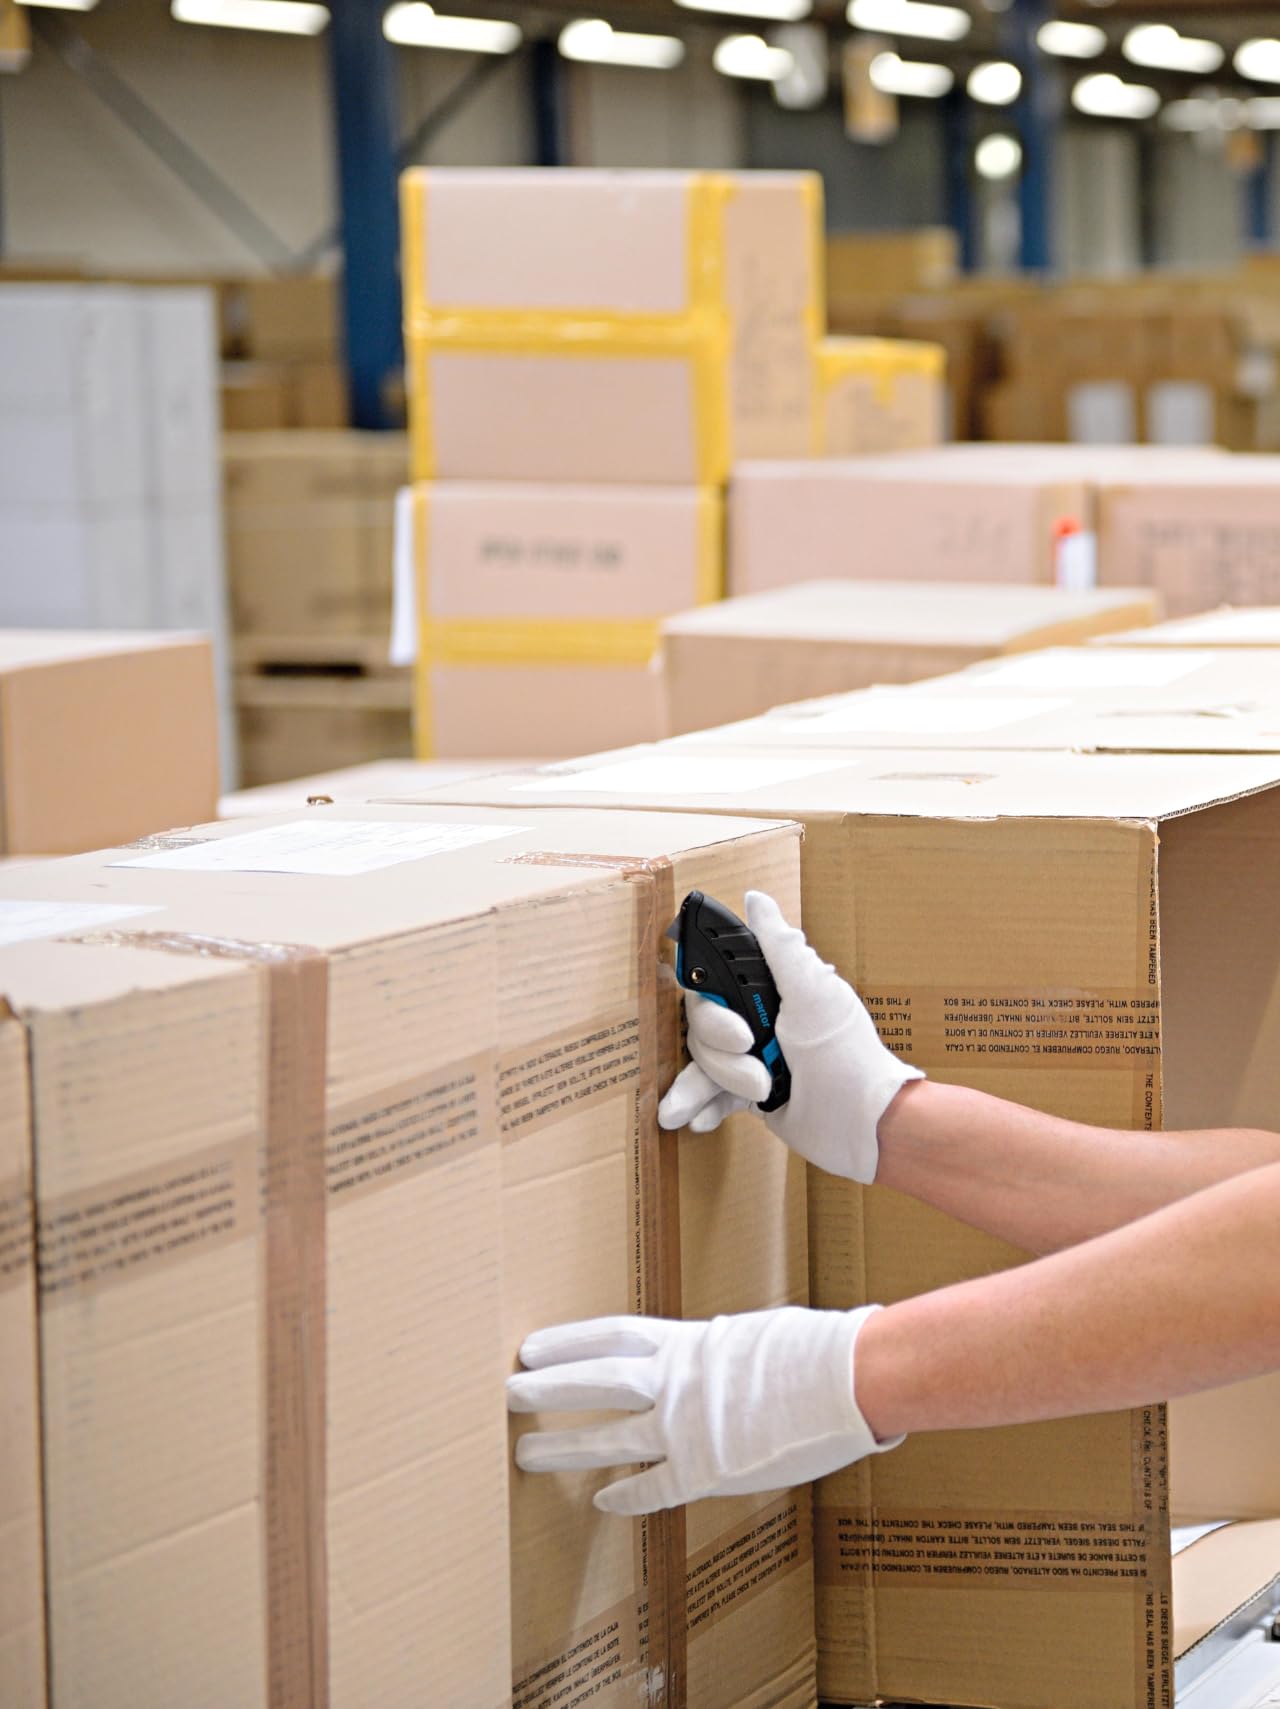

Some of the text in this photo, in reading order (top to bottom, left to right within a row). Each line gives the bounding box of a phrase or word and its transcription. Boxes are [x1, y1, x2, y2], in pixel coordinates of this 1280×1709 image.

[1148, 943, 1156, 985] TAMPERED
[866, 996, 910, 1006] IF THIS SEAL
[944, 998, 958, 1007] BOX
[961, 998, 974, 1007] THE
[978, 998, 987, 1007] OF
[990, 998, 1028, 1008] CONTENTS
[1031, 999, 1044, 1008] THE
[1048, 999, 1073, 1008] CHECK
[1075, 999, 1104, 1008] PLEASE
[1107, 999, 1127, 1008] WITH,
[752, 992, 771, 1028] martor
[944, 1014, 992, 1024] ÜBERPRÜFEN
[996, 1014, 1022, 1023] INHALT
[1059, 1015, 1079, 1024] BIT
[1083, 1015, 1112, 1024] SOLLTE,
[1116, 1015, 1133, 1024] SEIN
[881, 1028, 911, 1036] SI CETTE
[945, 1029, 1159, 1039] A ETE ALTEREE VEUILLEZ VERIFIER LE CONTENU DE LA BOITE
[906, 1042, 912, 1052] SI
[946, 1043, 963, 1052] CAJA
[965, 1043, 974, 1052] LA
[977, 1043, 986, 1052] DE
[988, 1043, 1029, 1053] CONTENIDO
[1032, 1044, 1040, 1053] EL
[1042, 1044, 1092, 1053] COMPRUEBEN
[1094, 1044, 1120, 1054] RUEGO
[1145, 1073, 1154, 1088] THE
[870, 1518, 879, 1528] OF
[881, 1519, 918, 1528] CONTENTS
[921, 1519, 933, 1529] THE
[937, 1520, 961, 1529] CHECK
[964, 1520, 991, 1530] PLEASE
[995, 1521, 1014, 1530] WITH,
[1016, 1521, 1055, 1531] TAMPERED
[1057, 1522, 1078, 1531] BEEN
[1080, 1522, 1095, 1531] HAS
[1098, 1522, 1116, 1532] SEAL
[1119, 1523, 1134, 1532] THIS
[888, 1534, 912, 1543] INHALT
[915, 1534, 944, 1544] KARTON
[948, 1535, 968, 1544] BITTE
[972, 1535, 1000, 1545] SOLLTE,
[1003, 1536, 1020, 1545] SEIN
[1024, 1536, 1060, 1546] VERLETZT
[1064, 1537, 1090, 1546] SIEGEL
[1092, 1538, 1119, 1547] DIESES
[1122, 1538, 1144, 1548] FALLS
[881, 1549, 914, 1558] CONTENU
[916, 1549, 924, 1559] LE
[926, 1550, 956, 1559] VERIFIER
[959, 1550, 991, 1560] VEUILLEZ
[993, 1551, 1024, 1560] ALTEREE
[1026, 1551, 1039, 1561] ETE
[1041, 1552, 1045, 1561] A
[1048, 1552, 1075, 1561] SURETE
[1077, 1552, 1086, 1562] DE
[1089, 1553, 1113, 1562] BANDE
[1115, 1553, 1137, 1563] CETTE
[880, 1563, 920, 1573] CONTENIDO
[923, 1564, 931, 1573] EL
[933, 1564, 981, 1574] COMPRUEBEN
[983, 1565, 1008, 1575] RUEGO
[1009, 1565, 1049, 1576] ALTERADO,
[1051, 1567, 1068, 1576] SIDO
[1071, 1567, 1080, 1576] HA
[1082, 1567, 1118, 1577] PRECINTO
[1120, 1568, 1138, 1577] ESTE
[1146, 1609, 1154, 1627] SEAL
[1146, 1631, 1154, 1646] HAS
[1146, 1649, 1155, 1669] BEEN
[1159, 1607, 1169, 1706] DIESES SIEGEL VERLETZT
